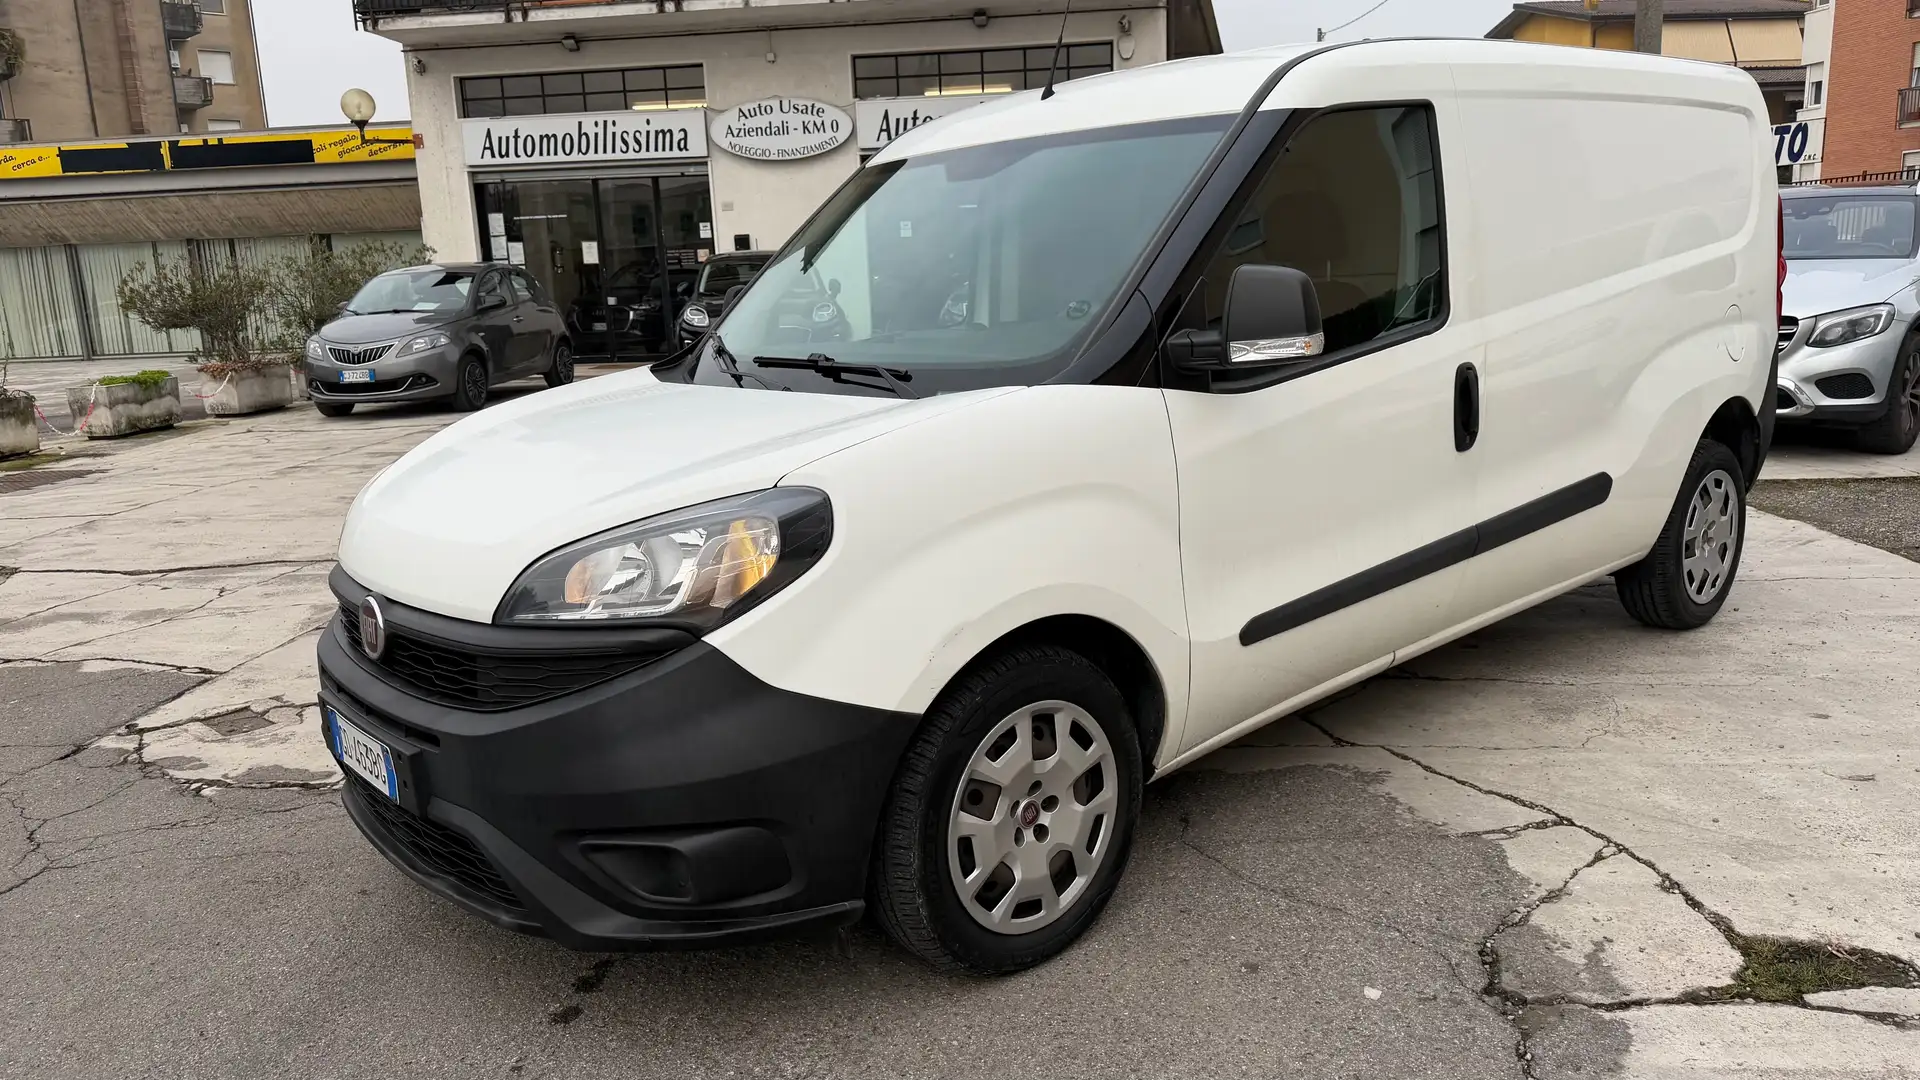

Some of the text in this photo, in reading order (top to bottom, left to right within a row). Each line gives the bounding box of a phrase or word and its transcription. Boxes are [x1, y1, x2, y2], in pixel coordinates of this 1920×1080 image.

[738, 99, 825, 122] Auto Usate
[480, 118, 690, 160] Automobilissima
[725, 120, 789, 139] Aziendali
[802, 120, 827, 135] KM
[831, 119, 839, 133] 0
[728, 141, 772, 158] NOLEGGIO
[777, 135, 839, 158] FINANZIAMENTI
[12, 159, 36, 171] cerca
